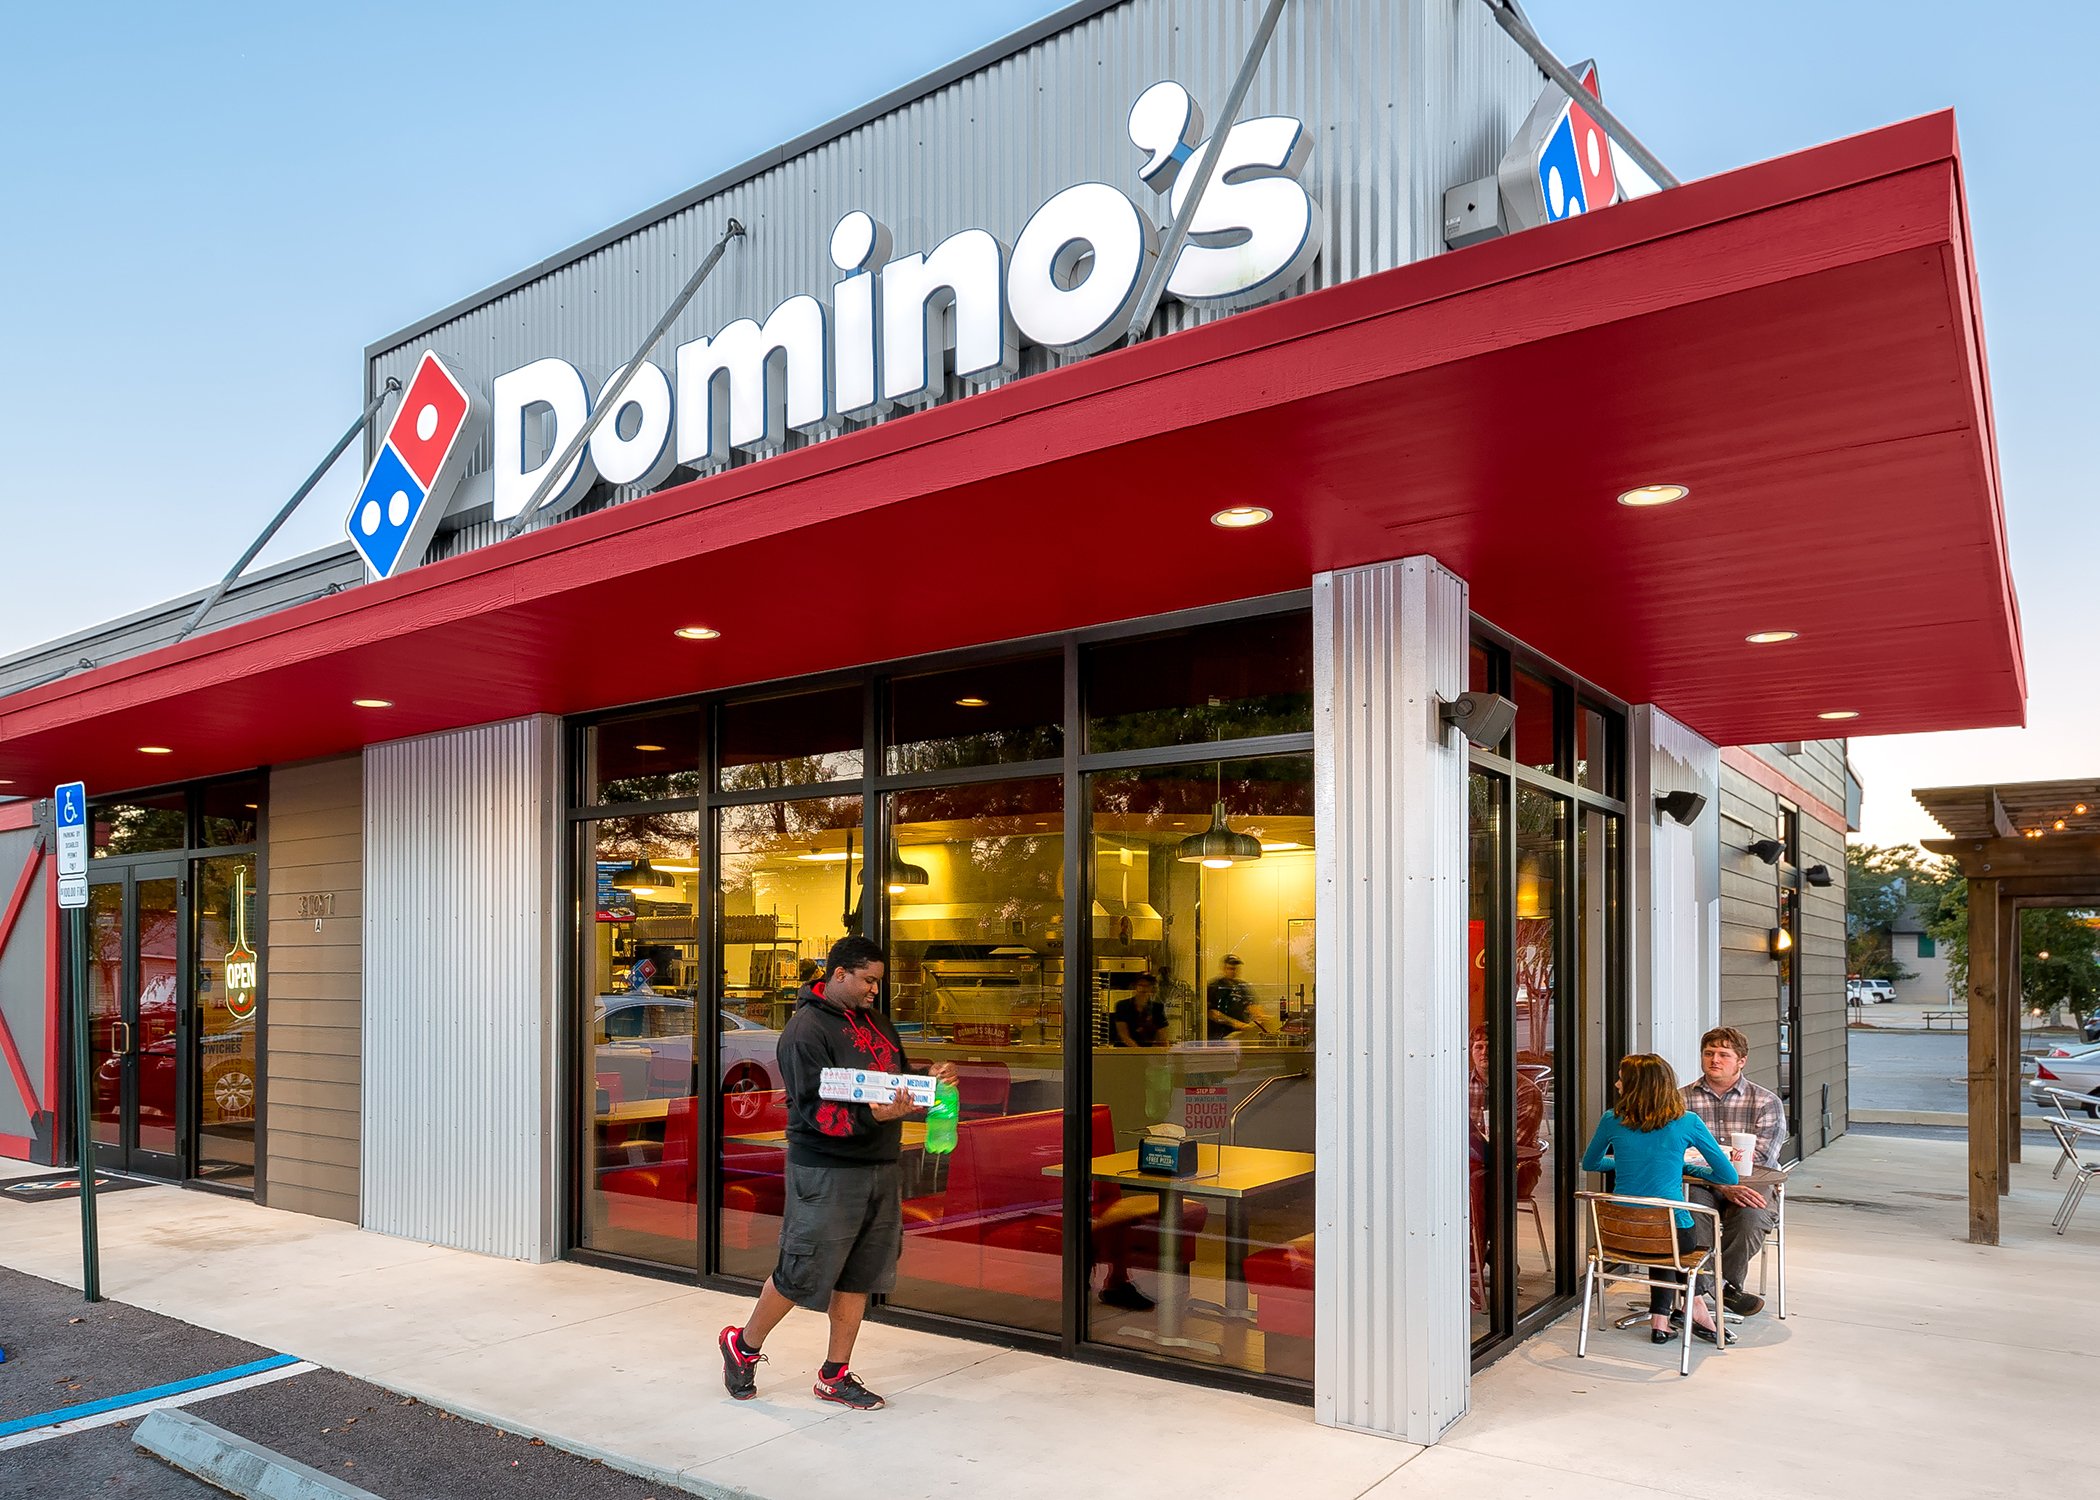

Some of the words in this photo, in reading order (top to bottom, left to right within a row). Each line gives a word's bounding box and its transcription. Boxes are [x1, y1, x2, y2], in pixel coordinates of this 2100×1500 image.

[492, 81, 1314, 522] Domino's
[227, 962, 256, 989] OPEN
[907, 1078, 930, 1088] MEDIUM
[1185, 1103, 1227, 1115] DOUGH
[1185, 1115, 1227, 1129] SHOW
